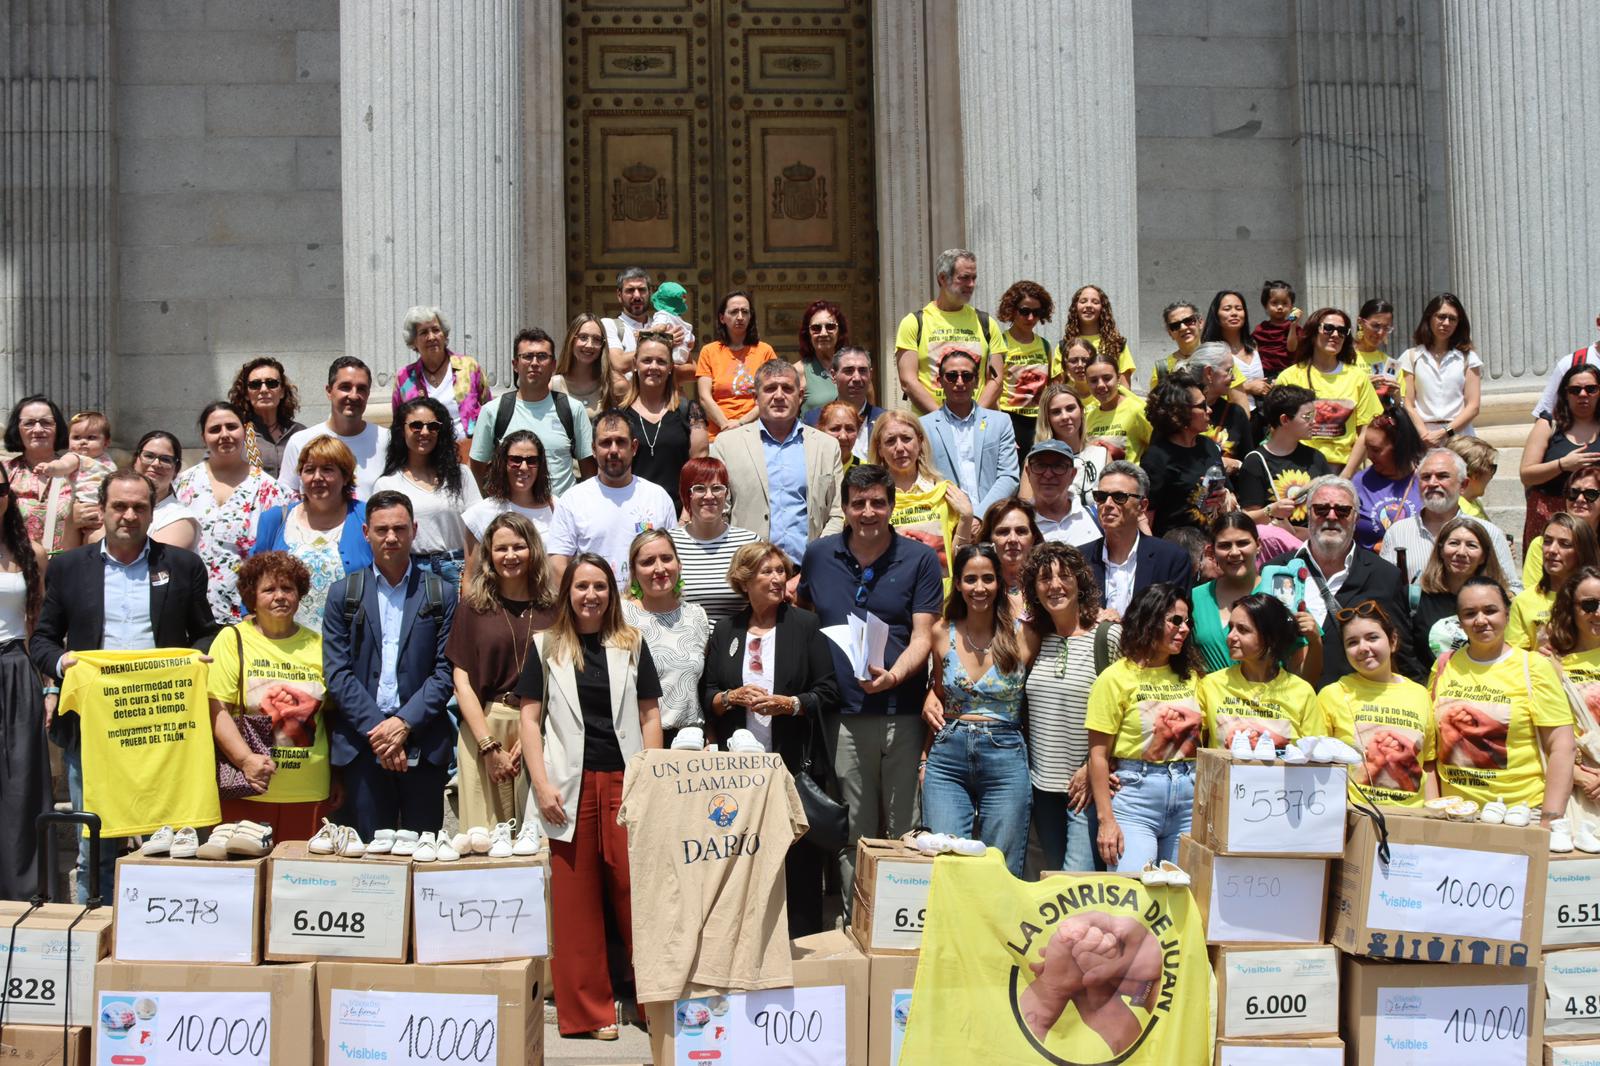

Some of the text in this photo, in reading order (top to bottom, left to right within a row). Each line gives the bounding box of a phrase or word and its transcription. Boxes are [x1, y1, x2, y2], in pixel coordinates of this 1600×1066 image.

[100, 657, 192, 675] ADRENOLEUCODISTROFIA
[282, 662, 292, 670] no
[103, 678, 192, 696] Una enfermedad rara
[114, 692, 184, 707] sin cura si no se
[114, 703, 188, 720] detecta a tiempo.
[1381, 706, 1390, 714] ya
[108, 726, 152, 738] Incluyamos
[154, 724, 162, 732] la
[178, 722, 187, 730] en
[188, 720, 196, 729] la
[1355, 714, 1372, 722] pero
[1385, 716, 1412, 727] historia
[120, 736, 148, 748] PRUEBA
[149, 734, 162, 744] DEL
[282, 760, 302, 769] vidas
[652, 756, 782, 778] UN GUERRERO
[676, 774, 766, 794] LLAMADO
[1234, 783, 1246, 800] 15
[1244, 789, 1326, 823] 5376
[681, 827, 760, 865] DARÍO
[886, 874, 931, 886] +visible
[1436, 875, 1515, 910] 10.000
[146, 897, 219, 924] 5278
[440, 898, 532, 934] 4577
[1144, 900, 1174, 937] DE
[294, 910, 365, 933] 6.048
[1007, 921, 1043, 956] LA
[1157, 940, 1180, 1012] JUAN
[1246, 994, 1307, 1016] 6.000
[754, 1010, 822, 1046] 9000
